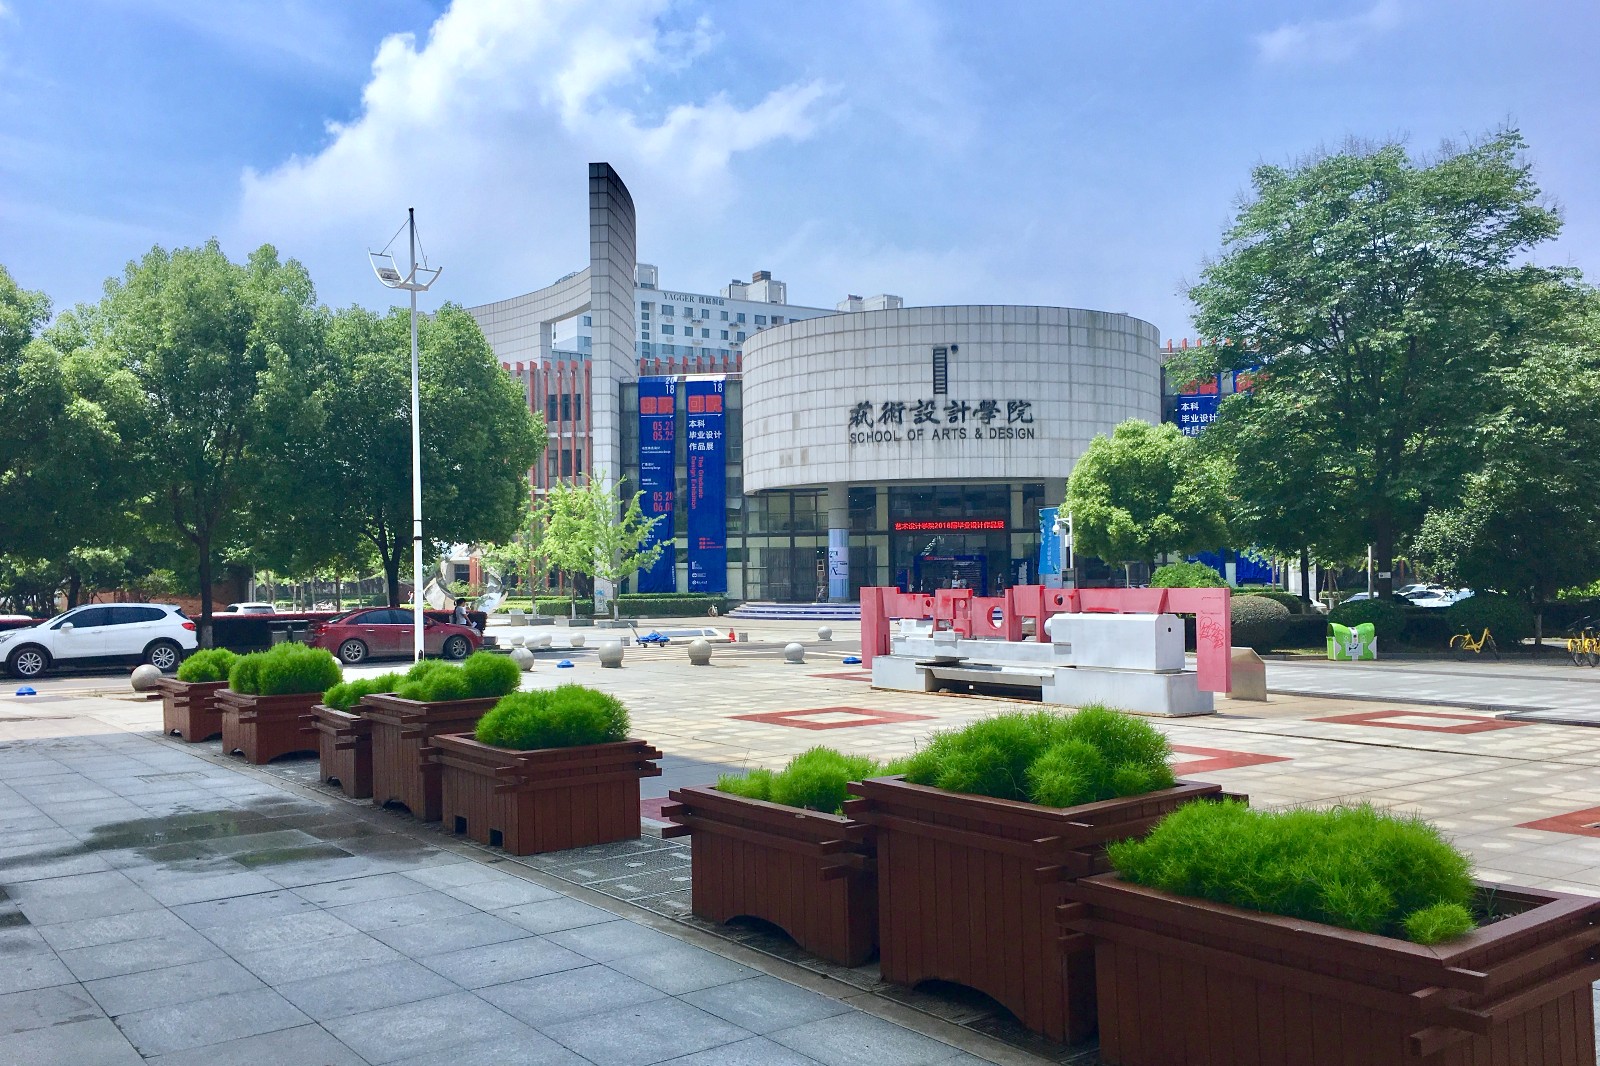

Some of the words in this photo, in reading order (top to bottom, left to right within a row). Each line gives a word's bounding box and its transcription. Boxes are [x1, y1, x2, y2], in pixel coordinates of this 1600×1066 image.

[664, 292, 694, 302] YAGGER
[665, 384, 675, 394] 18
[713, 383, 723, 393] 18
[1181, 402, 1199, 411] 本科
[849, 399, 1034, 428] 藝術設計學院
[1181, 413, 1218, 423] 毕业设计
[653, 421, 674, 430] 05.21
[689, 419, 705, 428] 本科
[653, 431, 674, 440] 05.25
[689, 431, 722, 439] 毕业设计
[849, 430, 901, 444] SCHOOL
[907, 429, 924, 440] OF
[932, 428, 967, 440] ARTS
[974, 428, 983, 440] &
[989, 428, 1035, 440] DESIGN
[689, 442, 714, 451] 作品展
